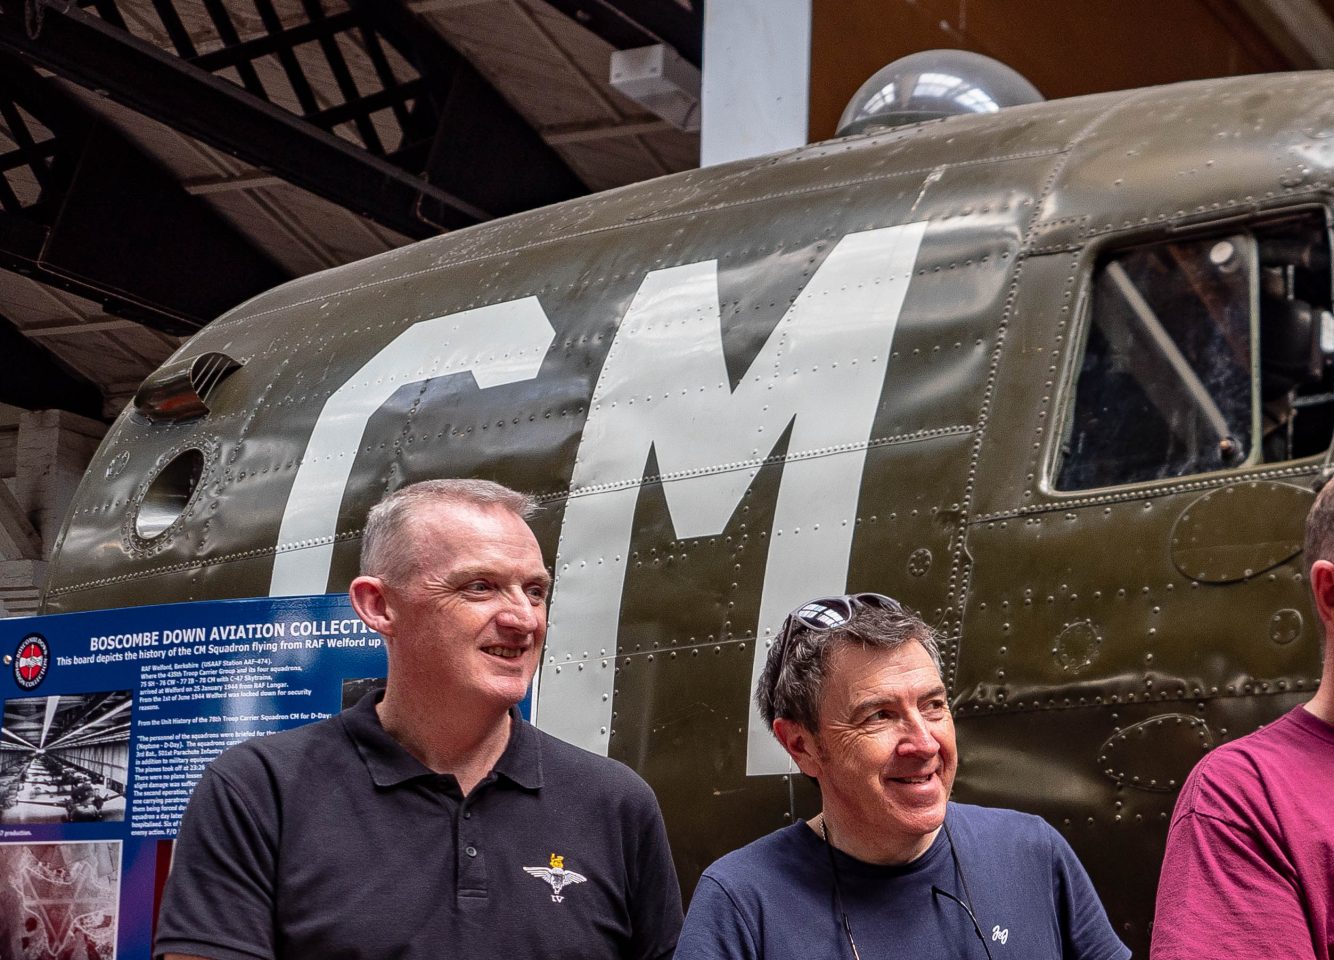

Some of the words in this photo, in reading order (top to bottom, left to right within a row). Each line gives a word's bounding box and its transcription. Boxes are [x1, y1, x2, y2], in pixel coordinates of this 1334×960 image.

[270, 221, 927, 776] CM
[90, 632, 159, 651] BOSCOMBE
[163, 628, 205, 644] DOWN
[210, 623, 285, 641] AVIATION
[290, 619, 377, 636] COLLECTI
[57, 656, 72, 666] This
[73, 654, 95, 665] board
[96, 652, 123, 664] depicts
[124, 651, 137, 660] the
[139, 648, 166, 659] history
[168, 647, 177, 656] of
[178, 646, 191, 655] the
[194, 645, 206, 654] CM
[208, 643, 249, 655] Squadron
[252, 642, 277, 652] flying
[280, 641, 302, 649] from
[305, 639, 324, 648] RAF
[327, 637, 365, 647] Welford
[369, 638, 381, 648] up
